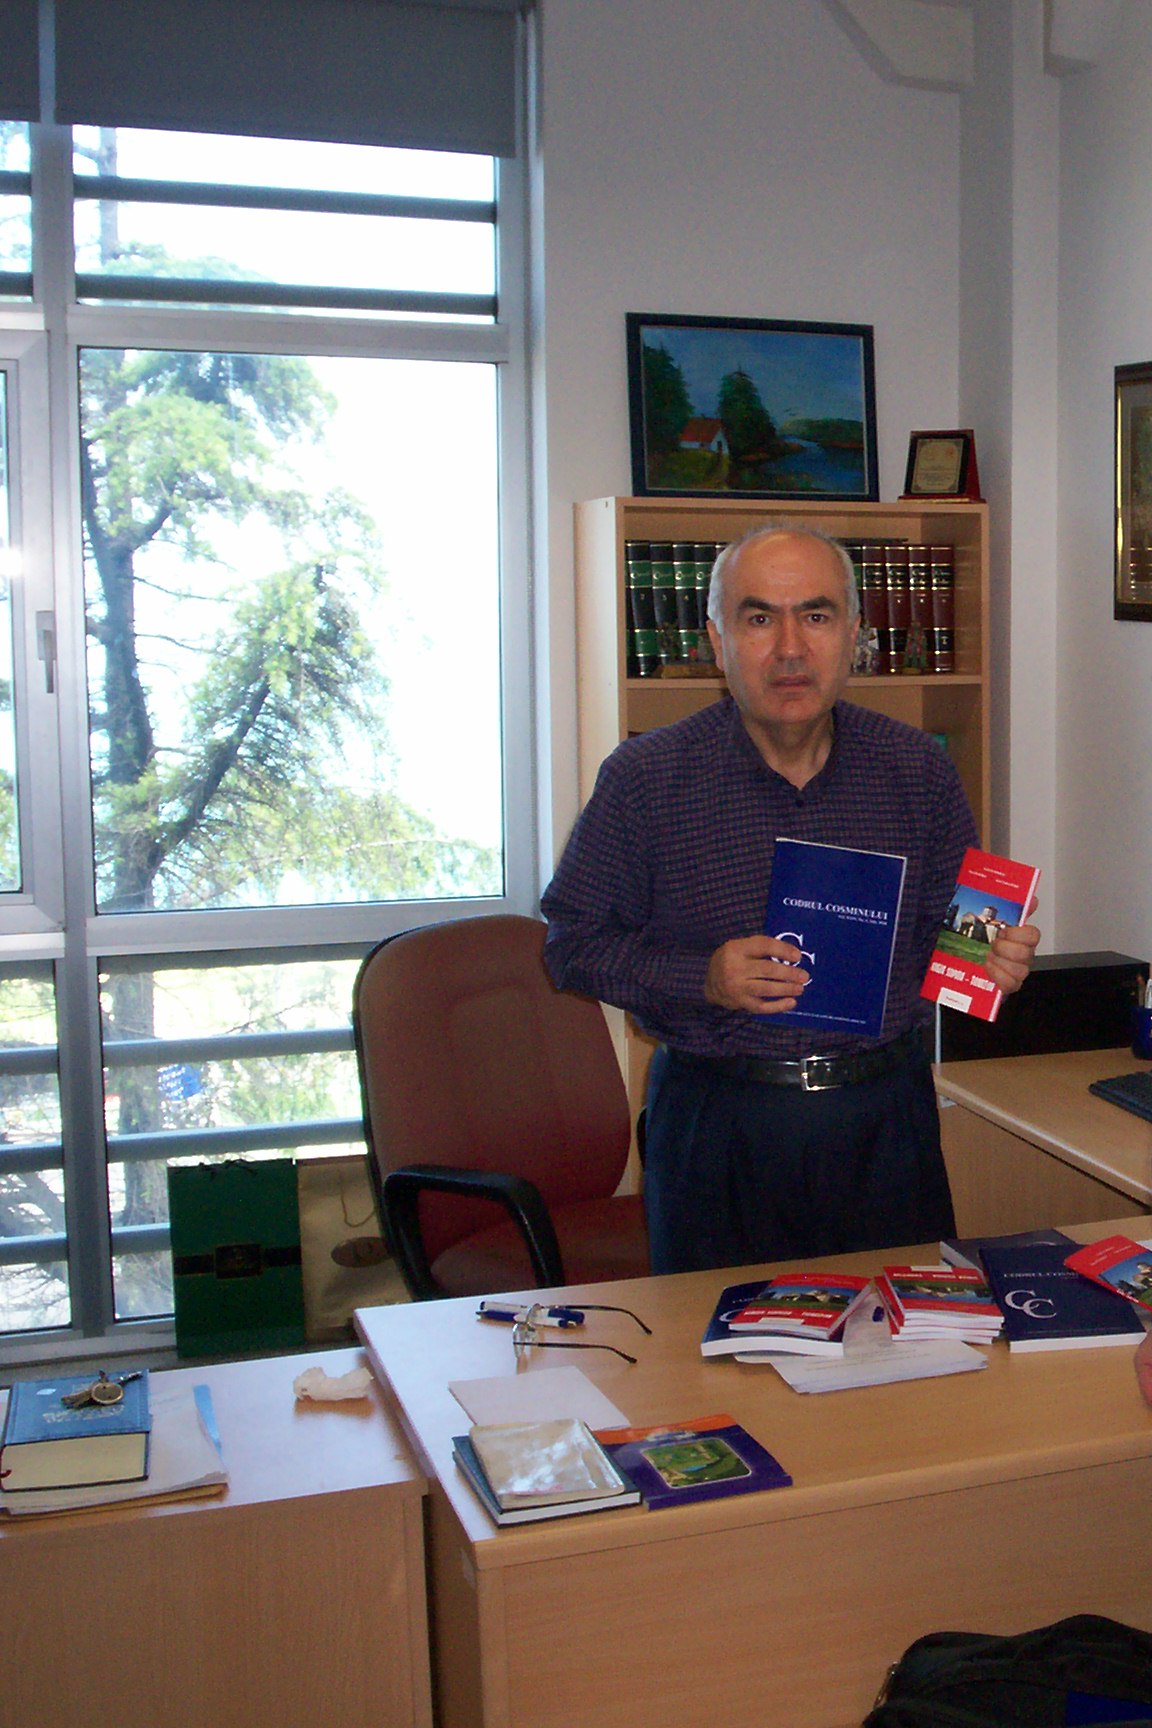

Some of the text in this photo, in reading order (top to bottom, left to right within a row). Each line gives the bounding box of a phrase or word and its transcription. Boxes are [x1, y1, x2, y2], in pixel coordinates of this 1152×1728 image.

[783, 897, 824, 911] CODRUL
[825, 903, 888, 920] COSMINULUI
[1004, 1289, 1057, 1319] CC
